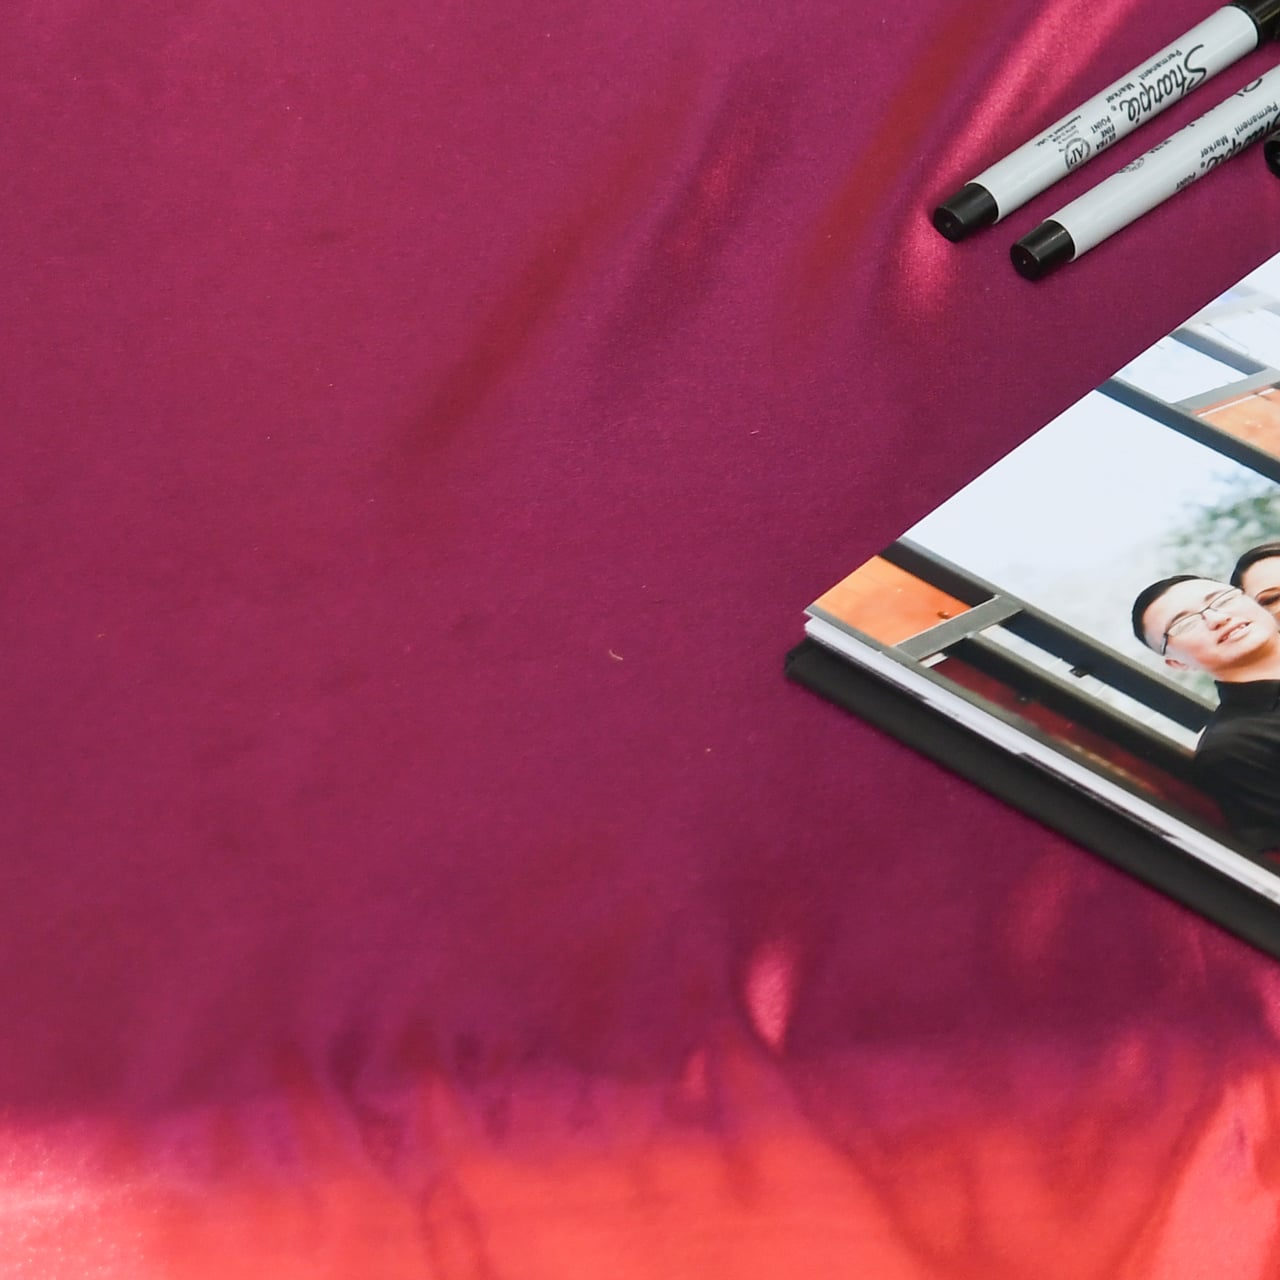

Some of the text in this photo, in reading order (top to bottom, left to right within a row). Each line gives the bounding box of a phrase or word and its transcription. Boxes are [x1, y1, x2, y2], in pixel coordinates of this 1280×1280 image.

[1105, 49, 1182, 104] Permanent Marker
[1119, 43, 1207, 125] Sharpie
[1090, 115, 1112, 134] POINT
[1101, 124, 1116, 139] FINE
[1235, 101, 1279, 135] Permanent
[1200, 134, 1229, 159] Marker
